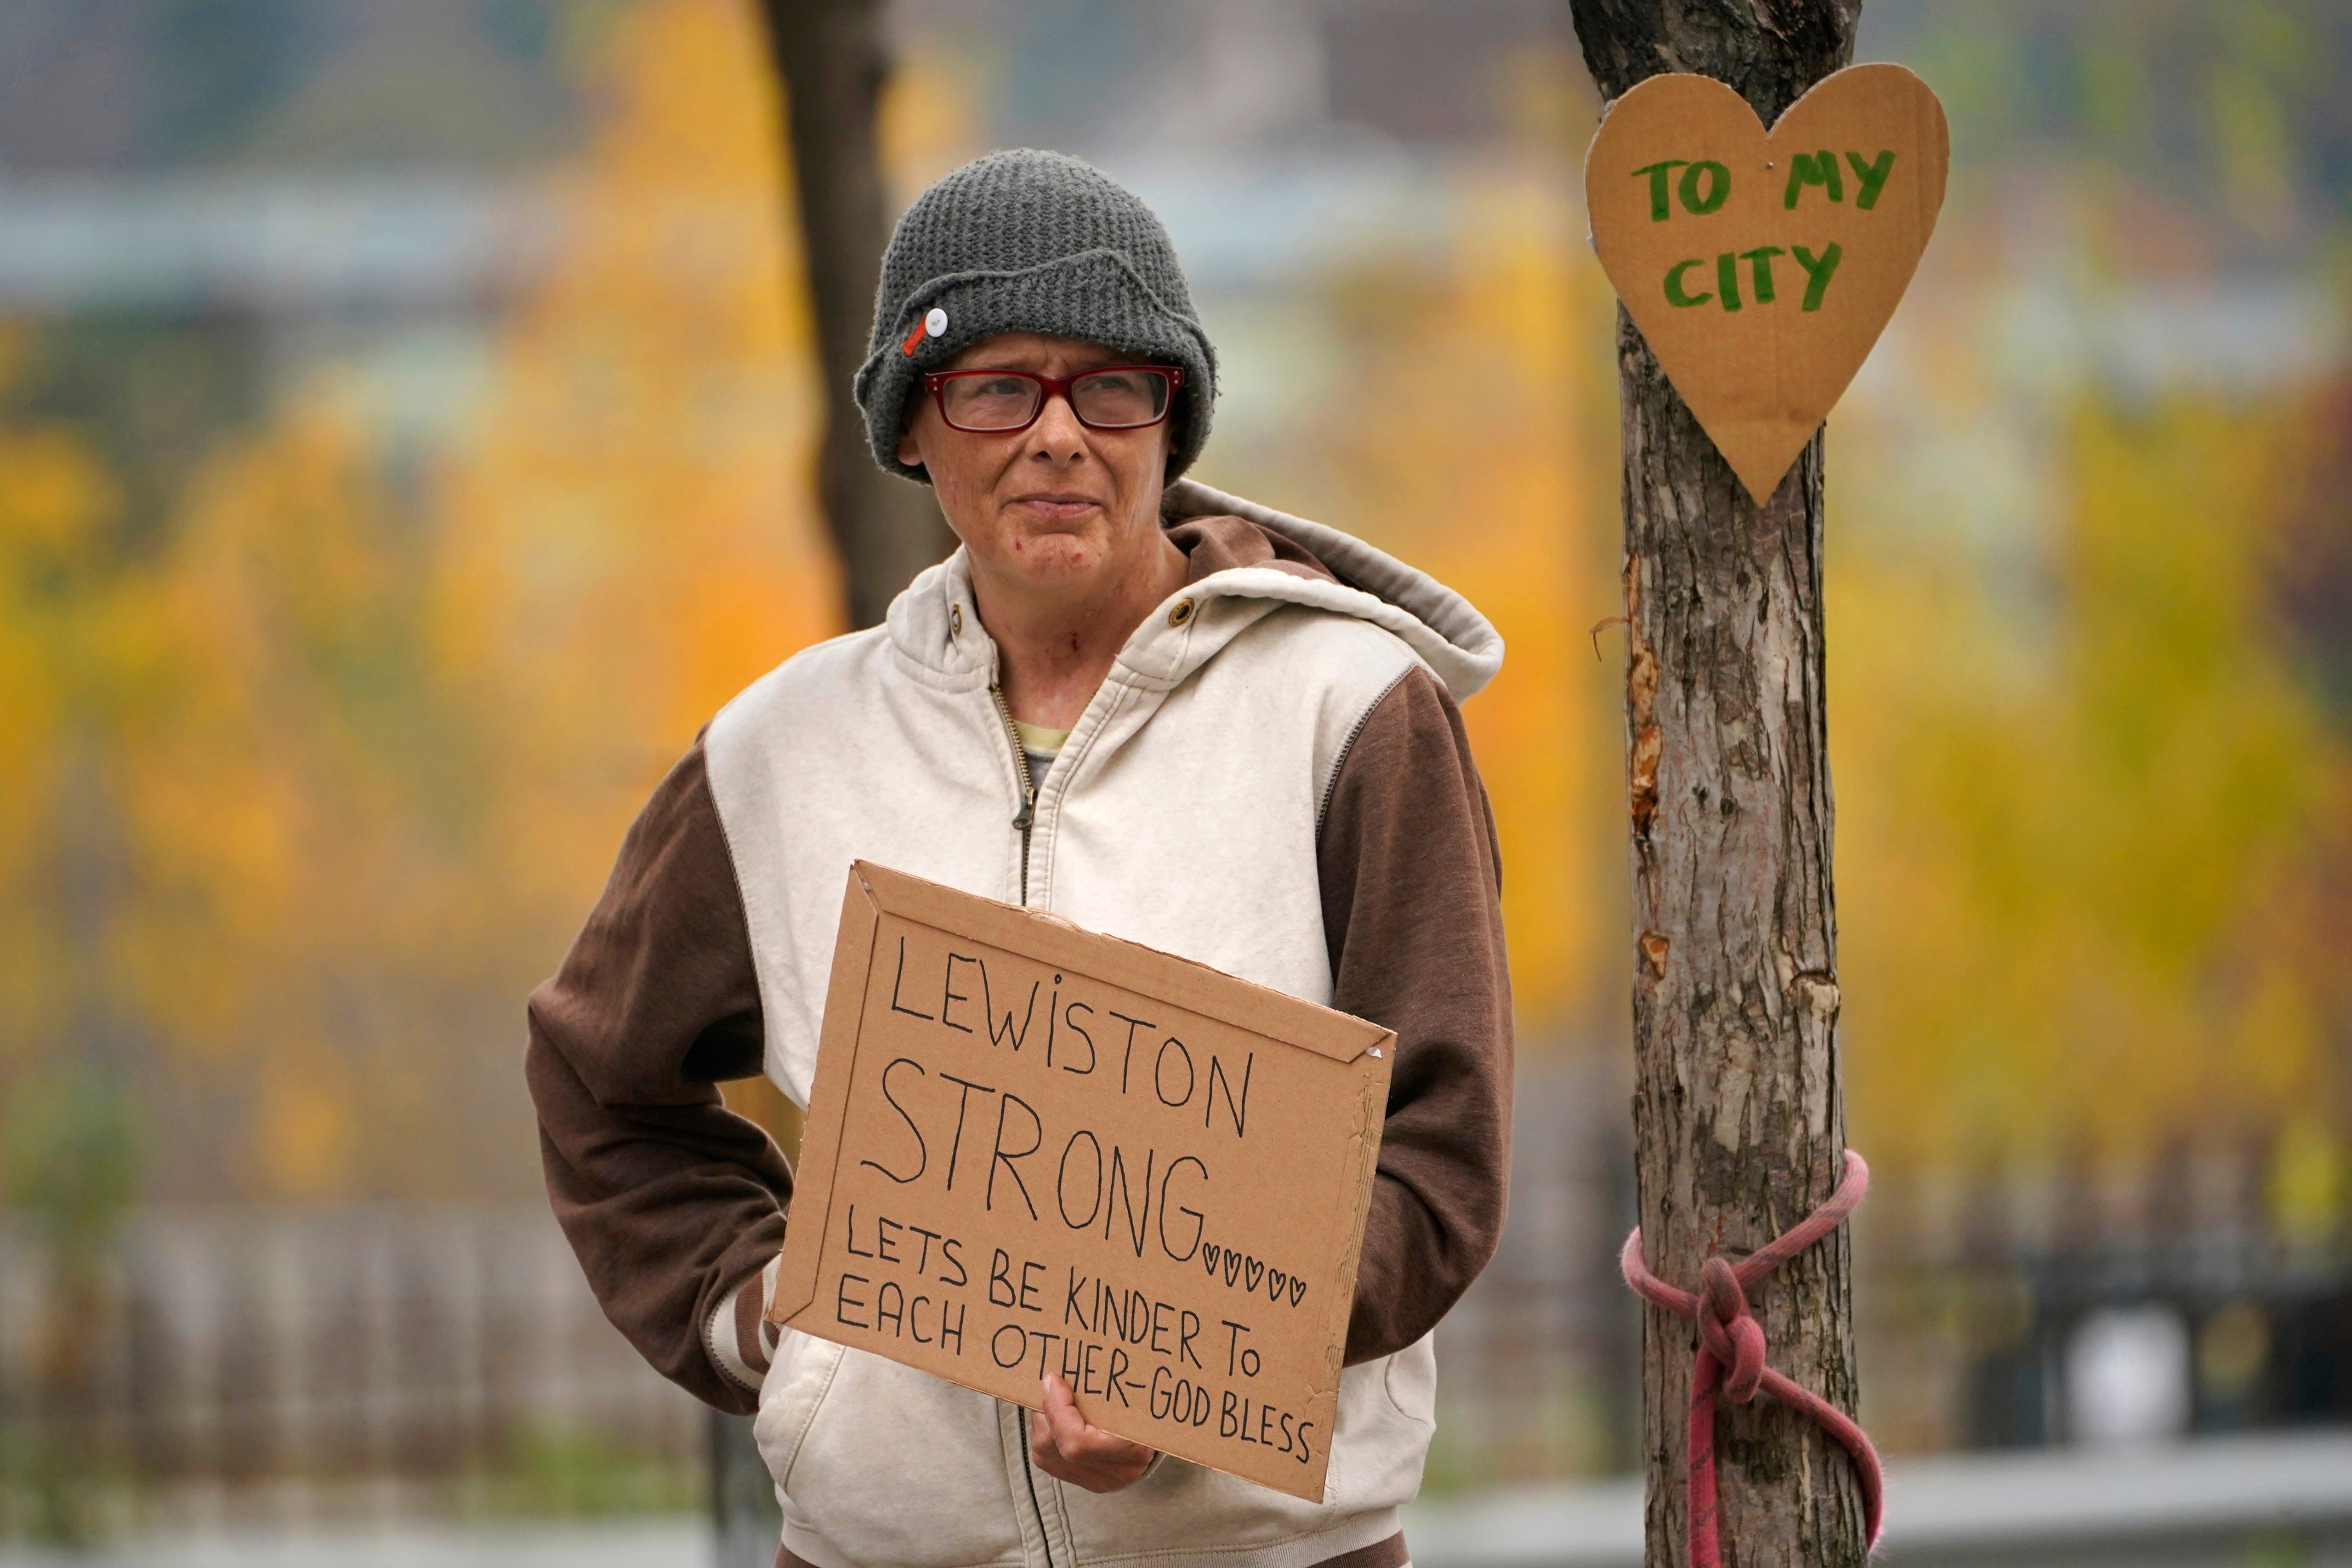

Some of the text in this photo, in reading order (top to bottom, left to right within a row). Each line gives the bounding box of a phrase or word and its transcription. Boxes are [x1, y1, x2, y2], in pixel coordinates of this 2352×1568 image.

[1631, 150, 1896, 222] TO MY
[1663, 241, 1842, 312] CITY
[860, 1058, 1208, 1262] STRONG
[837, 1273, 965, 1356] EACH
[1220, 1391, 1314, 1464] BLESS
[848, 1204, 967, 1287] LETS
[989, 1248, 1046, 1312] BE
[1065, 1267, 1202, 1369] KINDER
